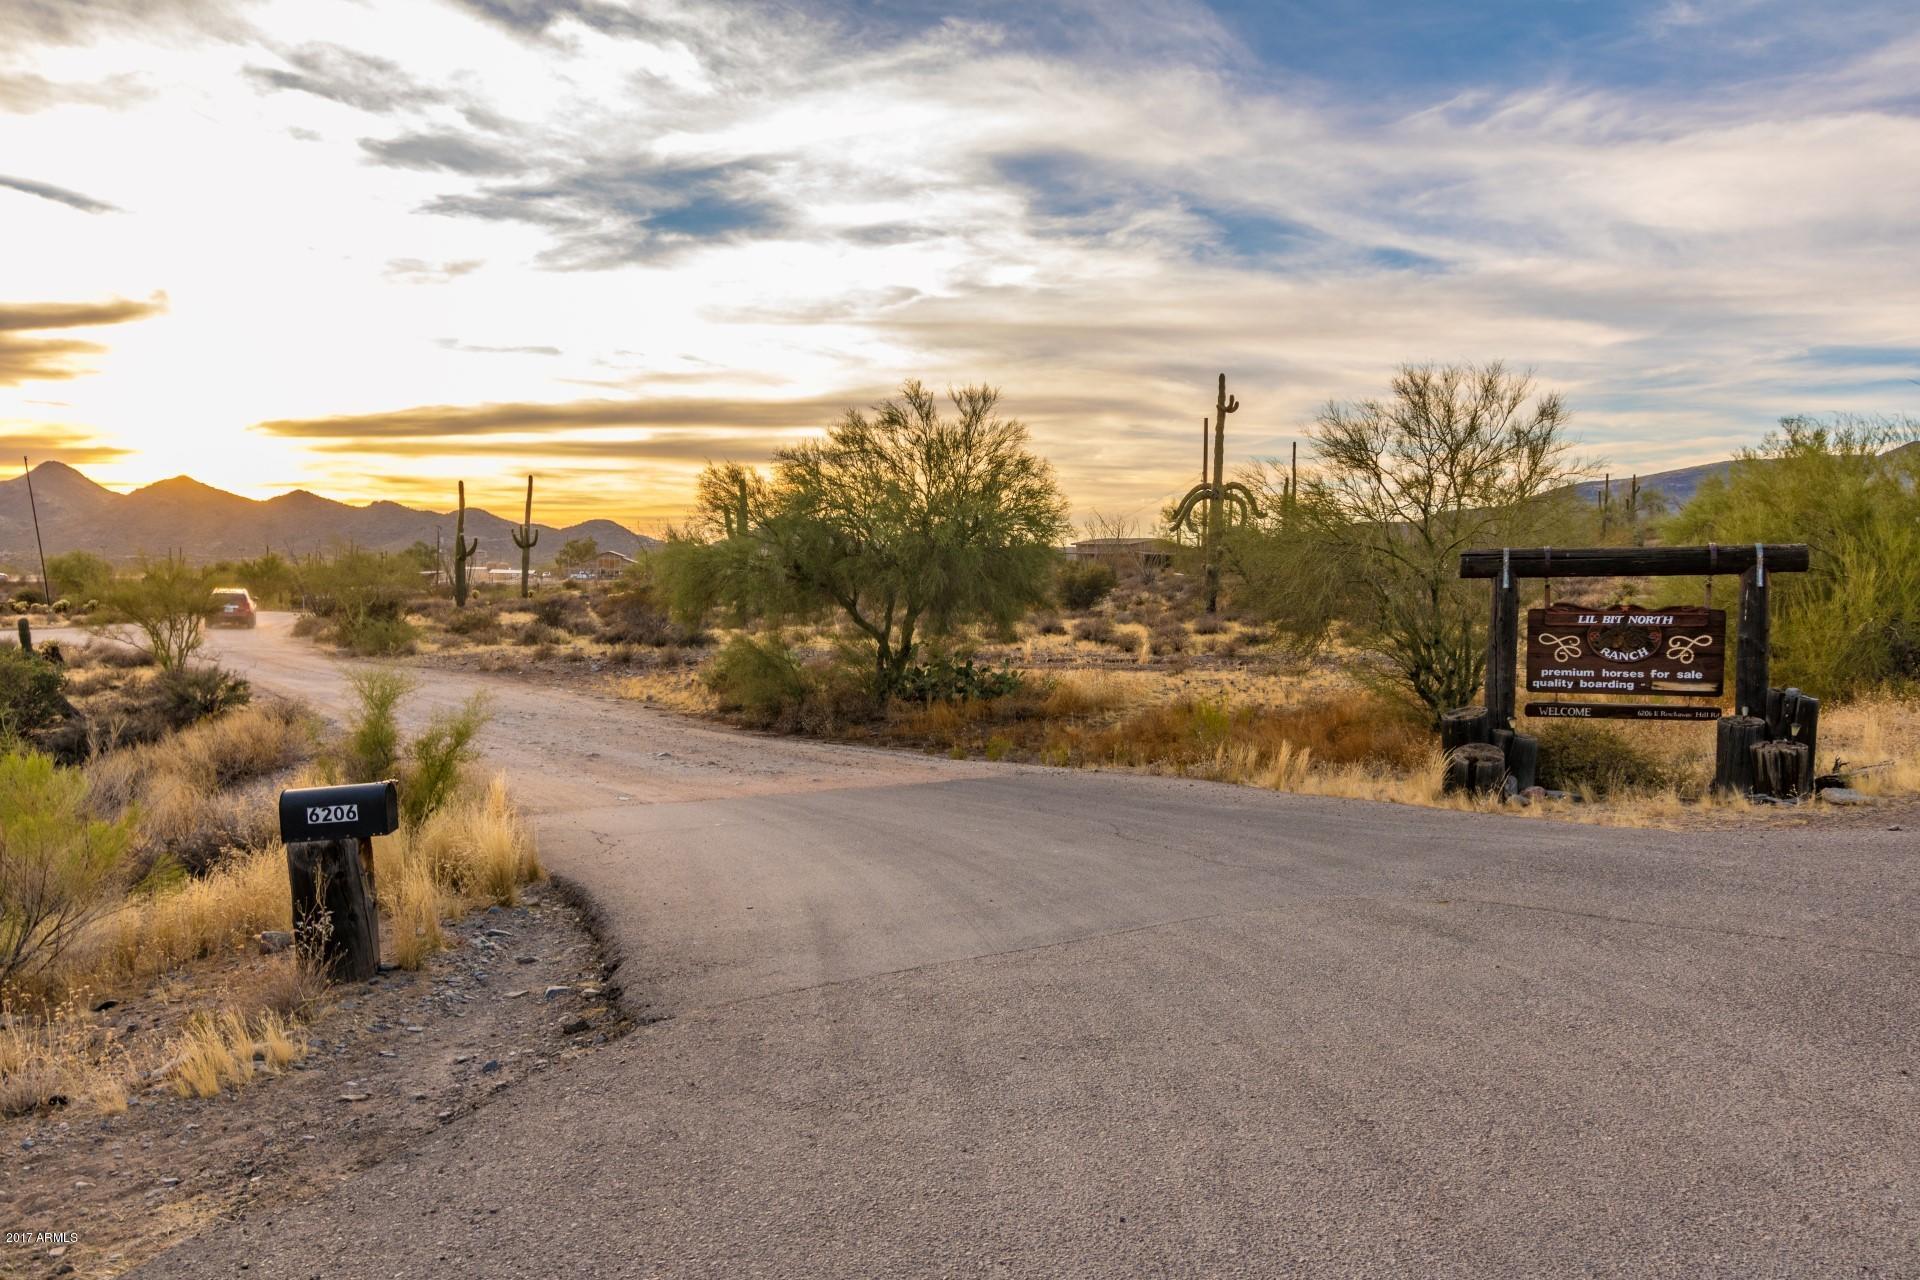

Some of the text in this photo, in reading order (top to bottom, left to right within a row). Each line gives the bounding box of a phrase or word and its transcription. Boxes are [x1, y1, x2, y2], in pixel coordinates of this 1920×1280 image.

[1577, 615, 1673, 625] LIL BIT NORTH
[1600, 647, 1649, 661] RANCH
[1541, 668, 1703, 679] premium horses for sale
[1532, 679, 1573, 689] quality
[1580, 679, 1634, 690] boarding
[1539, 706, 1591, 716] WELCOME
[308, 805, 358, 823] 6206
